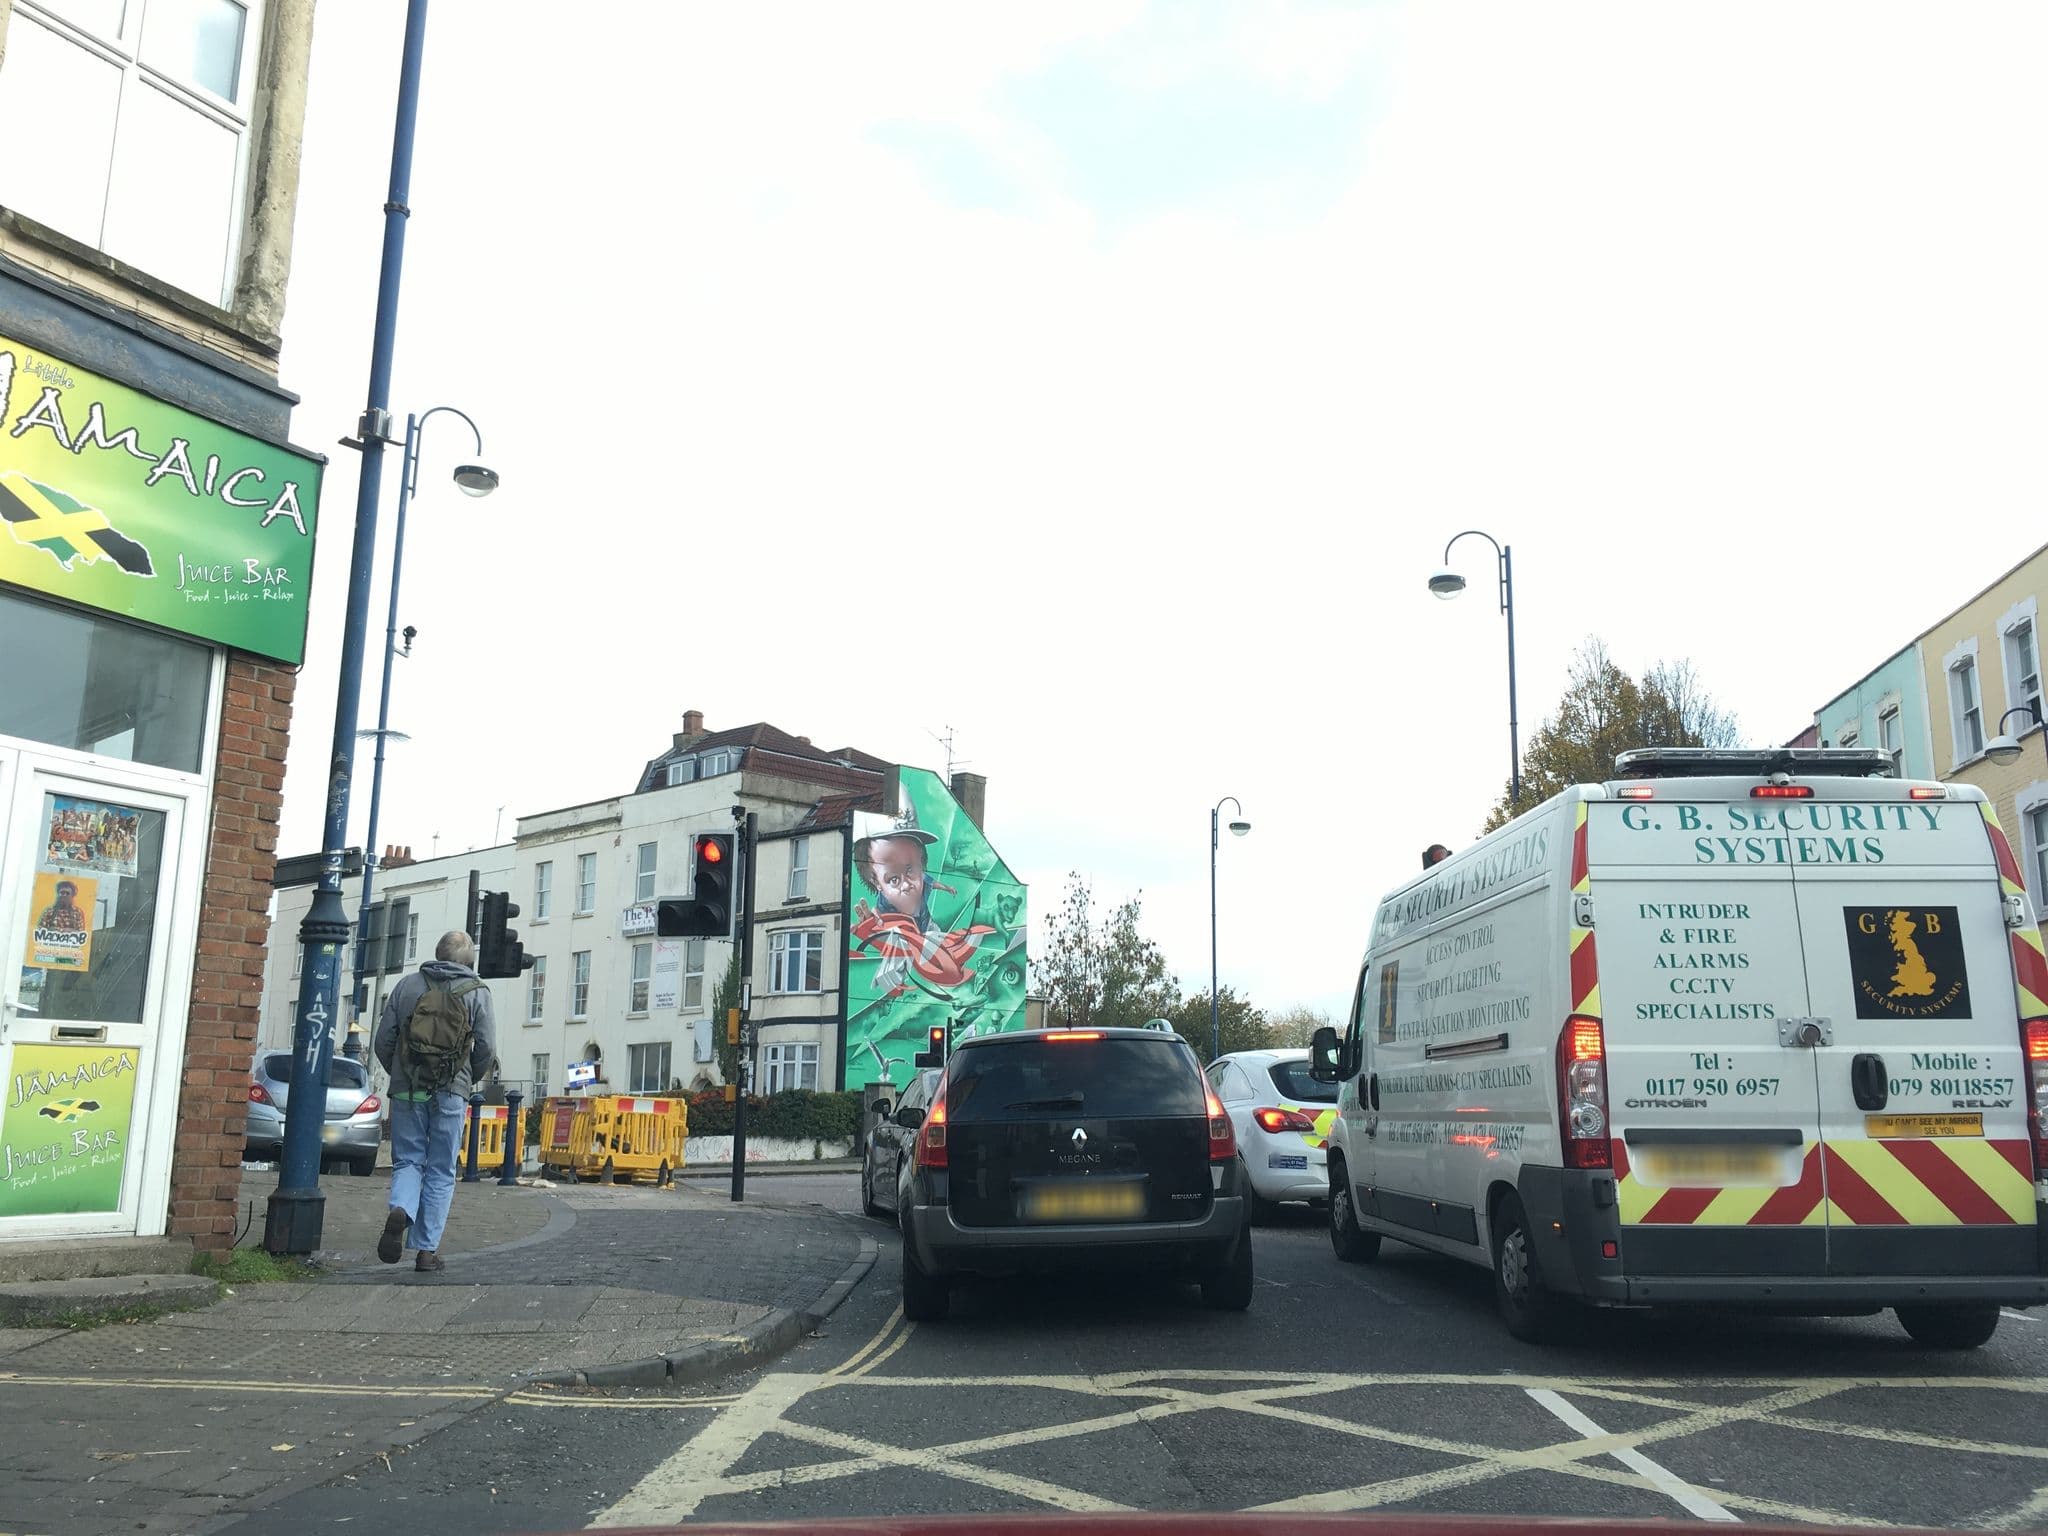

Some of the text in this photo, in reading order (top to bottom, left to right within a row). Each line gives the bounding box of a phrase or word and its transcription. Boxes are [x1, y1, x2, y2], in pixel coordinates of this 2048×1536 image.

[23, 355, 75, 389] Little
[184, 589, 209, 602] Food
[224, 588, 249, 604] Juice
[262, 587, 294, 602] Relax
[1622, 803, 1943, 831] G. B. SECURITY
[1694, 836, 1884, 864] SYSTEMS
[1405, 866, 1468, 926] SECURITY
[1471, 827, 1549, 895] SYSTEMS
[623, 907, 642, 921] The
[1638, 903, 1751, 919] INTRUDER
[1859, 913, 1941, 934] G B
[1425, 924, 1495, 966] ACCESS CONTROL
[1659, 928, 1737, 944] & FIRE
[1653, 953, 1750, 969] ALARMS
[1417, 961, 1501, 1003] SECURITY LIGHTING
[1669, 977, 1735, 994] C.C.TV
[1860, 980, 1963, 1015] SECURITY SYSTEMS
[1398, 995, 1530, 1041] CENTRAL STATION MONITORING
[1636, 1003, 1775, 1020] SPECIALISTS
[1690, 1053, 1719, 1070] Tel
[1911, 1053, 1977, 1071] Mobile
[10, 1052, 134, 1109] JAMAICA
[1479, 1064, 1532, 1090] SPECIALISTS
[1646, 1078, 1780, 1096] 0117 950 6957
[1889, 1078, 2014, 1097] 079 80118557
[1952, 1100, 2014, 1109] RELAY
[11, 1172, 37, 1191] Food
[51, 1165, 77, 1182] Juice
[91, 1151, 121, 1167] Relax
